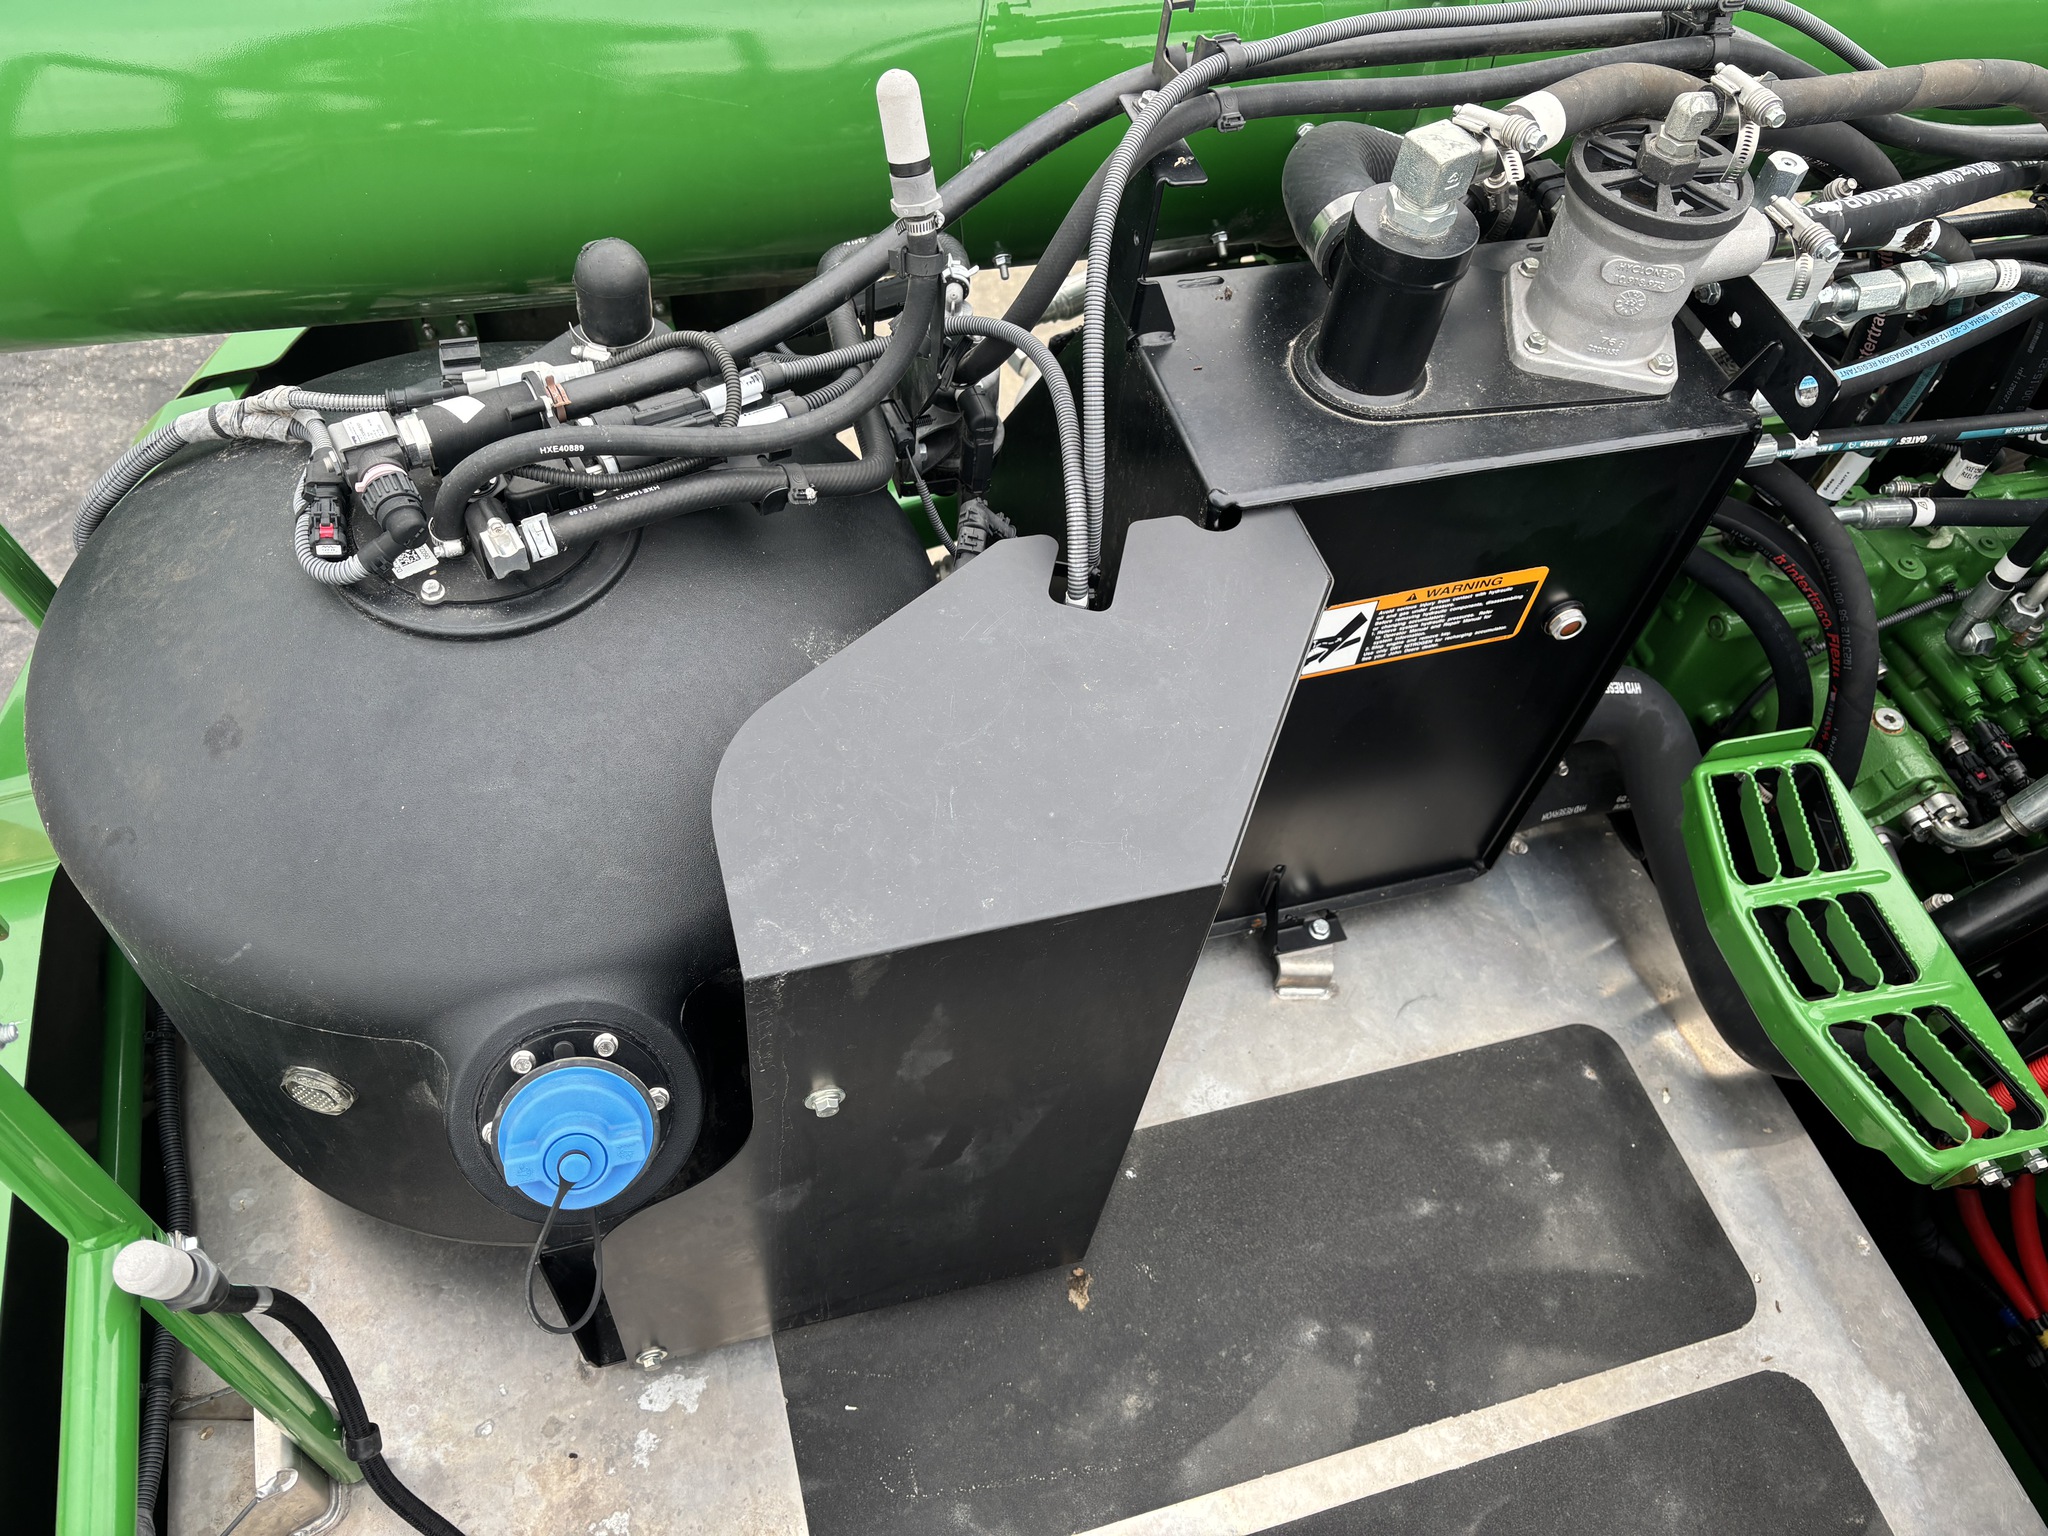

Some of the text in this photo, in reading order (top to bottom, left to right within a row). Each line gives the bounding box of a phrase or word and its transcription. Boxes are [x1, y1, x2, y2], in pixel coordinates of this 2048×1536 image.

[2001, 299, 2016, 311] 3625
[1989, 307, 2001, 317] PSI
[1968, 314, 1989, 327] MSHA
[1939, 323, 1968, 340] IC-227/12
[1920, 337, 1939, 349] FRAS
[1879, 347, 1913, 367] ABRASION
[1838, 360, 1878, 378] RESISTANT
[1898, 435, 1928, 445] GATES
[539, 443, 584, 455] HXE40889
[1426, 576, 1504, 598] WARNING
[1624, 681, 1642, 695] HYD
[1573, 803, 1588, 814] HYD
